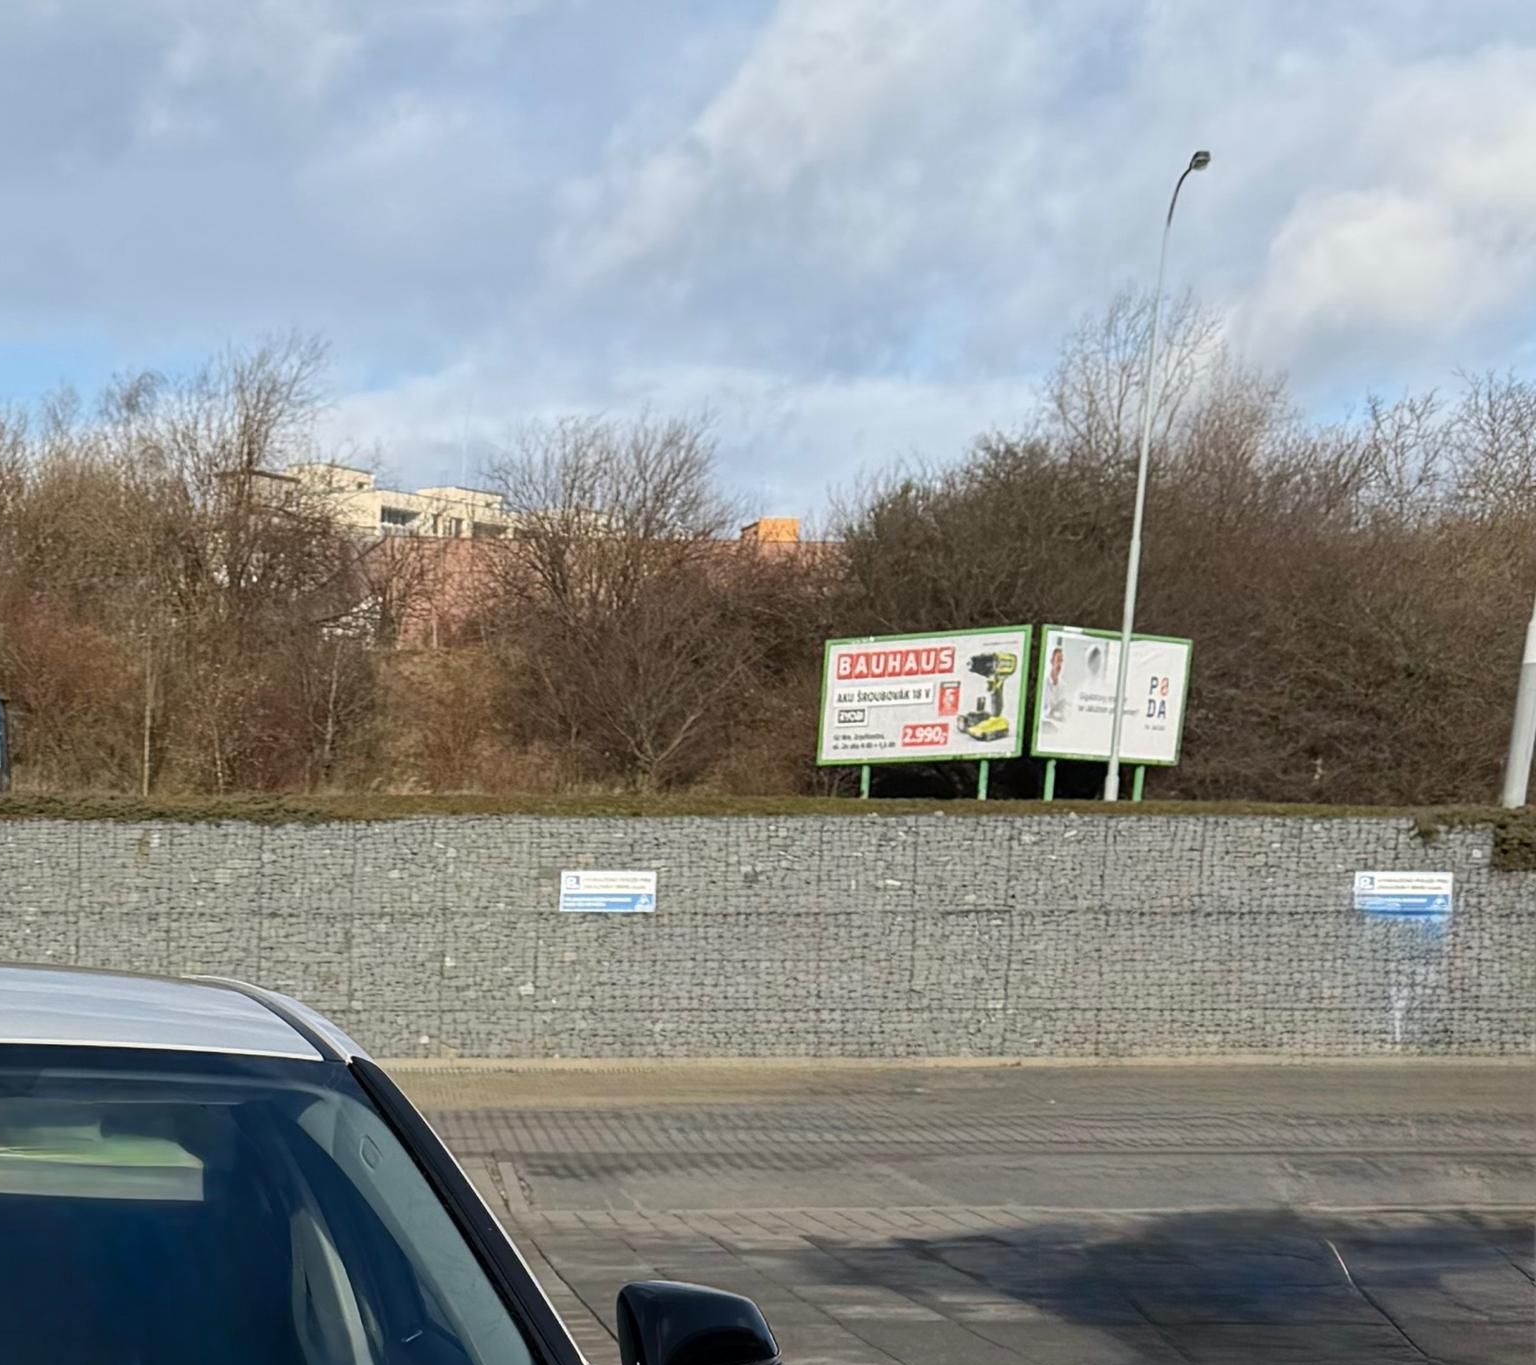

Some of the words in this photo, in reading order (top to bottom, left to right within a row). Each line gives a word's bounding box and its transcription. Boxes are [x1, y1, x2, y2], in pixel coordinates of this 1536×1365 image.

[838, 648, 953, 676] BAUHAUS
[837, 692, 855, 703] AKU
[1146, 698, 1167, 719] DA
